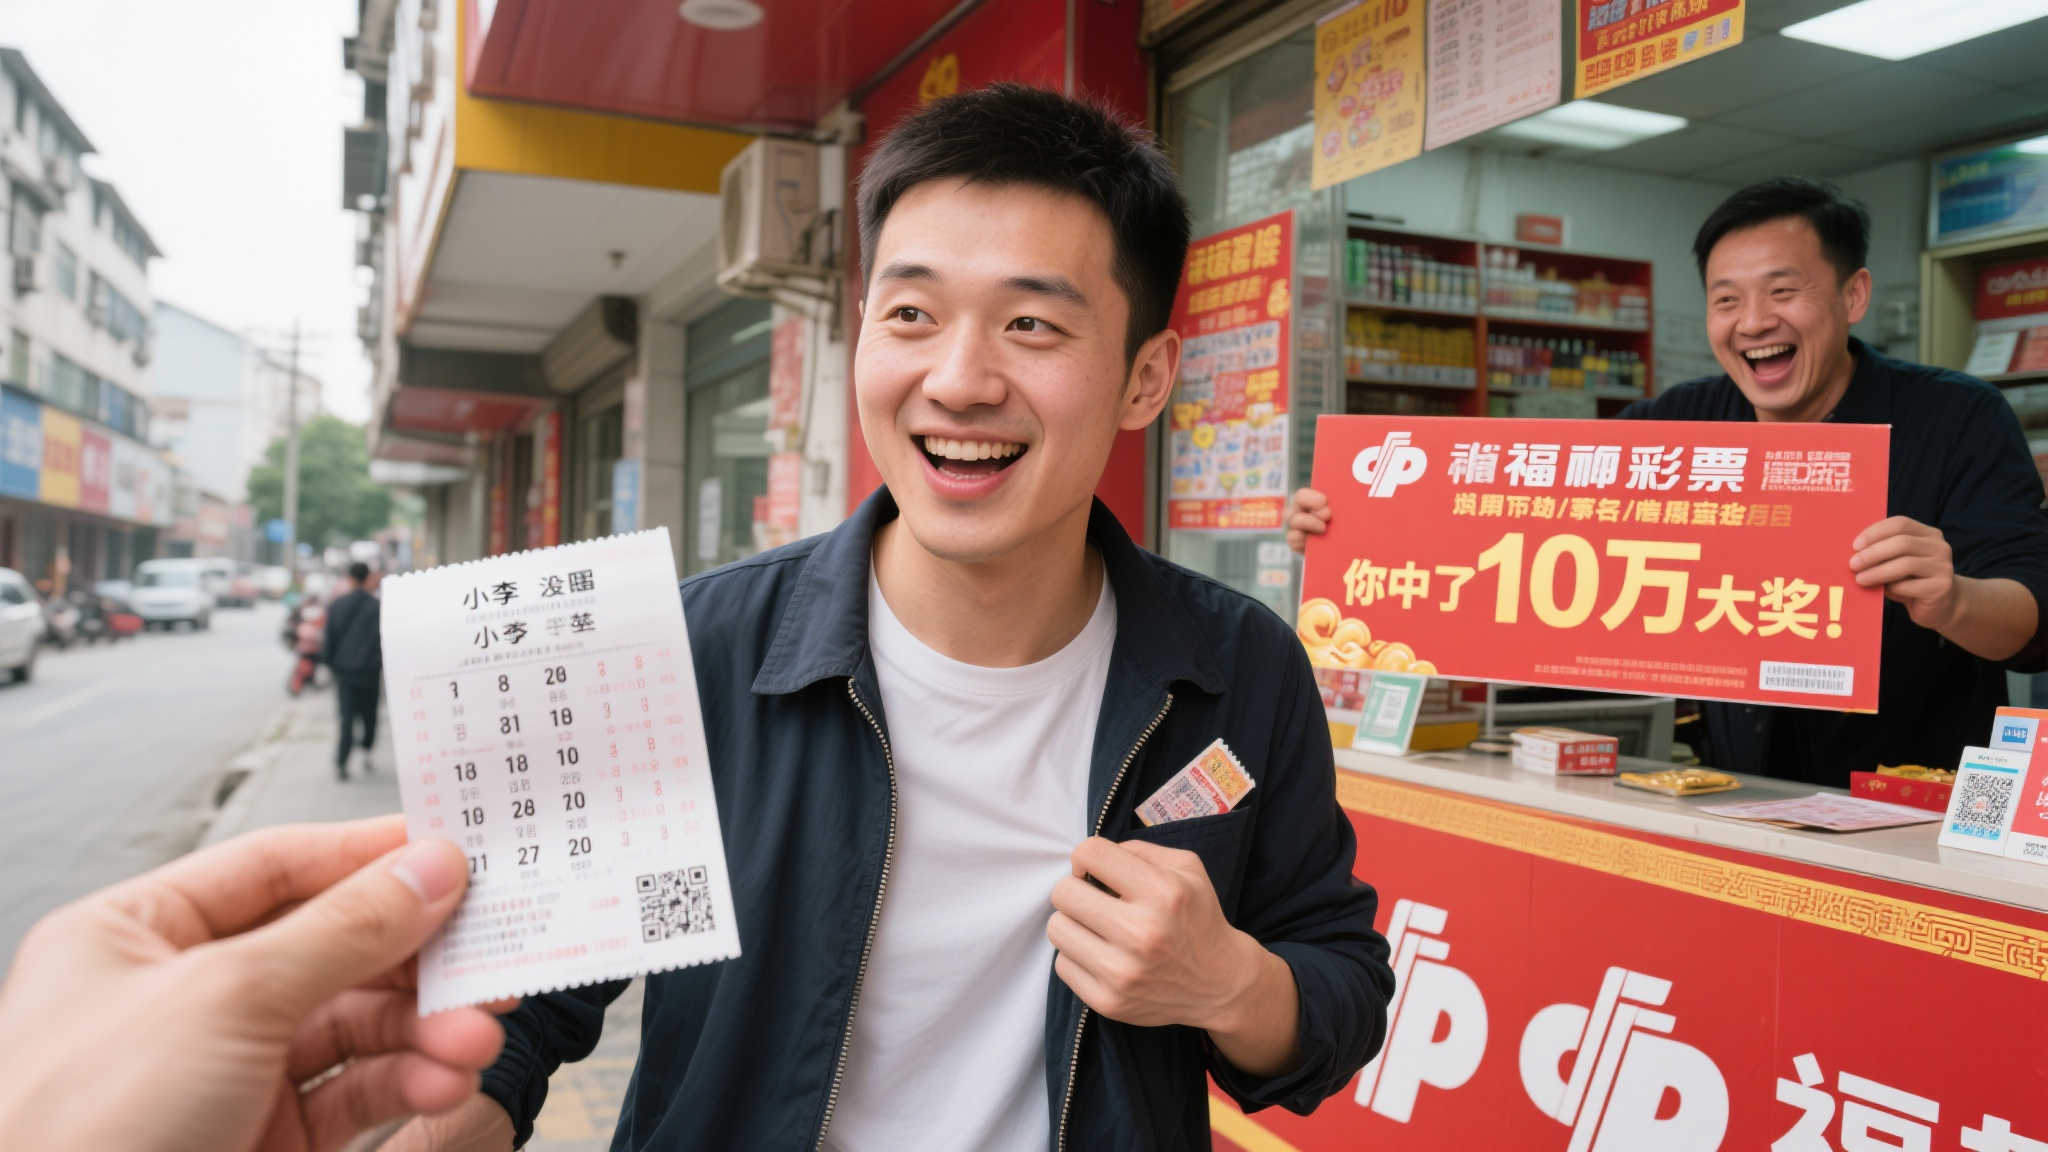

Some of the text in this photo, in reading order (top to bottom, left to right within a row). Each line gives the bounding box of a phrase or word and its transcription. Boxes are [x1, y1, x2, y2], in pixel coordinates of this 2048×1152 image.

[463, 581, 519, 610] 小李
[1342, 531, 1845, 640] 你中了10万大奖!
[556, 746, 579, 766] 10
[518, 846, 540, 866] 27
[568, 837, 592, 857] 20
